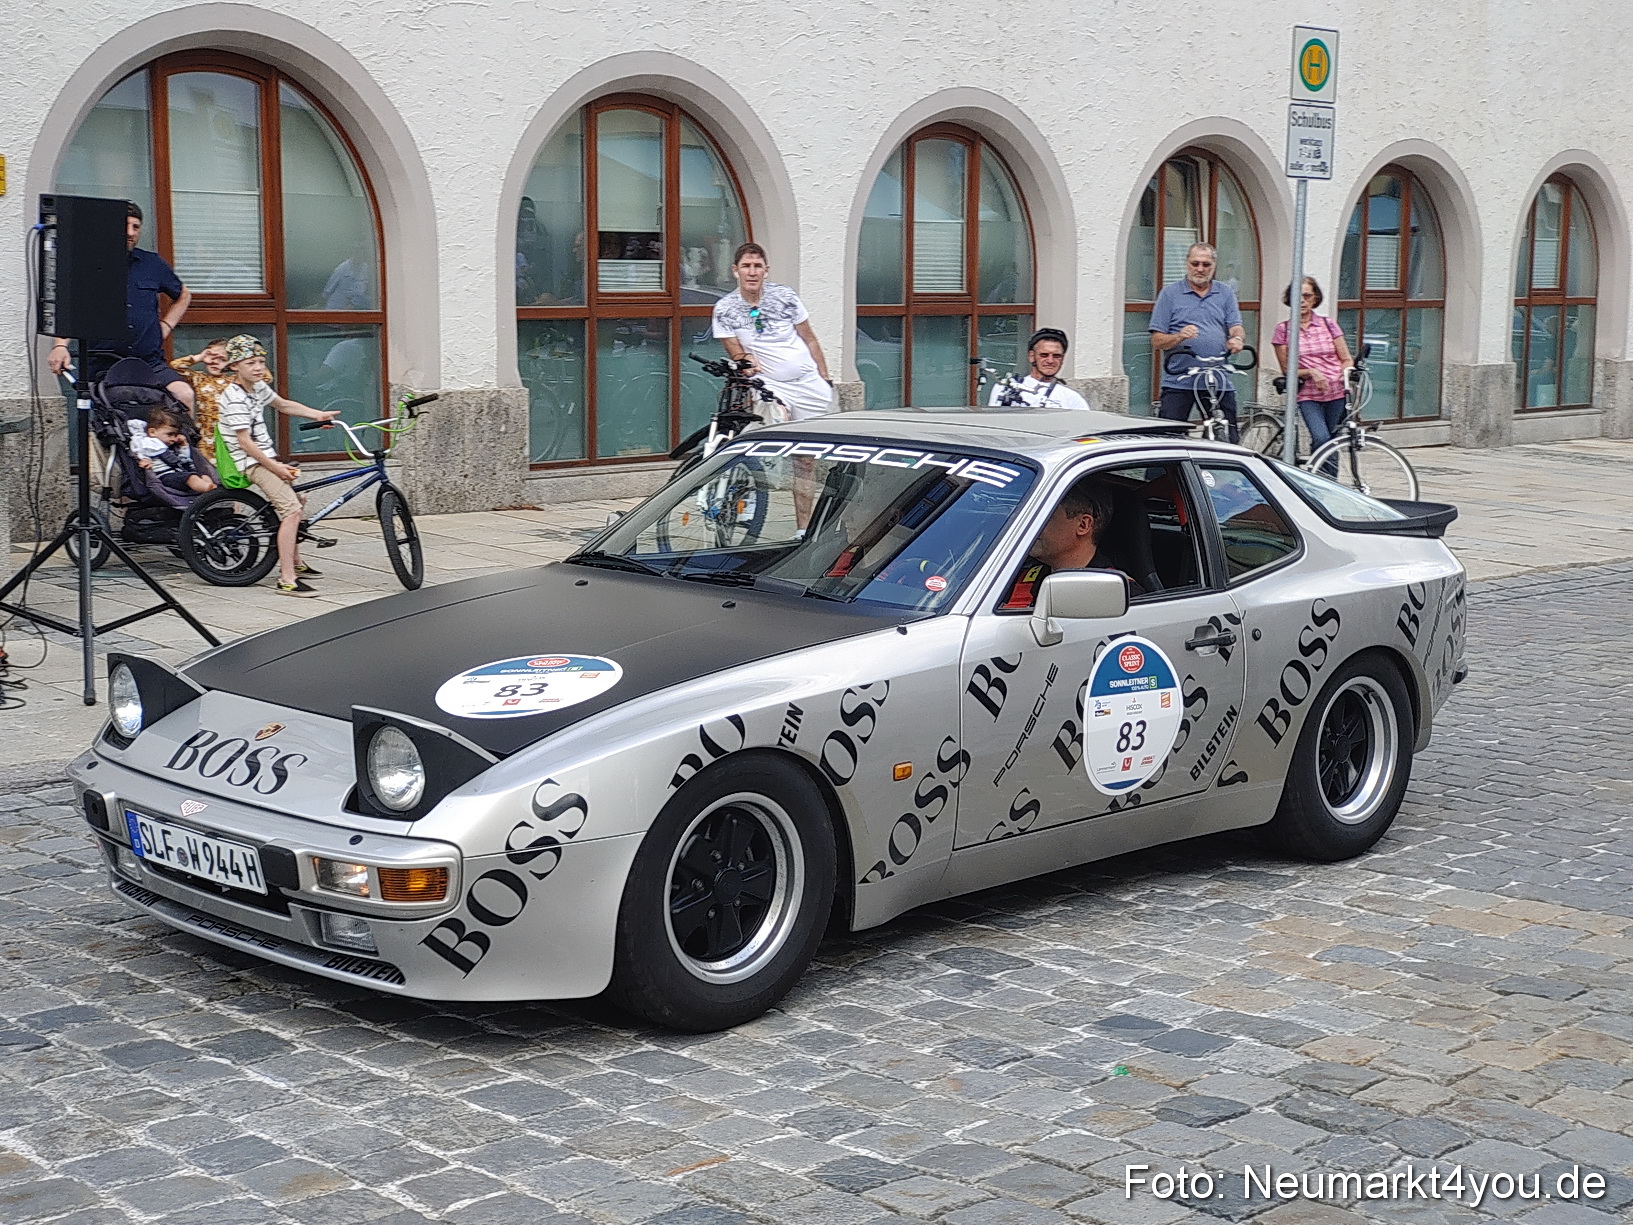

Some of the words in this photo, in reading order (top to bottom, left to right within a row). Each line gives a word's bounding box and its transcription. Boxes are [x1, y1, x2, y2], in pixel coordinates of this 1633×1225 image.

[1291, 111, 1331, 129] Schulbus
[718, 441, 1021, 488] PORSCHE
[494, 682, 548, 698] 83
[1109, 677, 1149, 688] SONNLEITNER
[1254, 597, 1341, 749] BOSS
[993, 662, 1059, 787] PORSCHE
[1116, 720, 1147, 753] 83
[1189, 704, 1238, 781] BILSTEIN
[162, 728, 309, 795] BOSS
[139, 821, 174, 862] SLF
[417, 777, 589, 979] BOSS
[184, 914, 282, 950] PORSCHE
